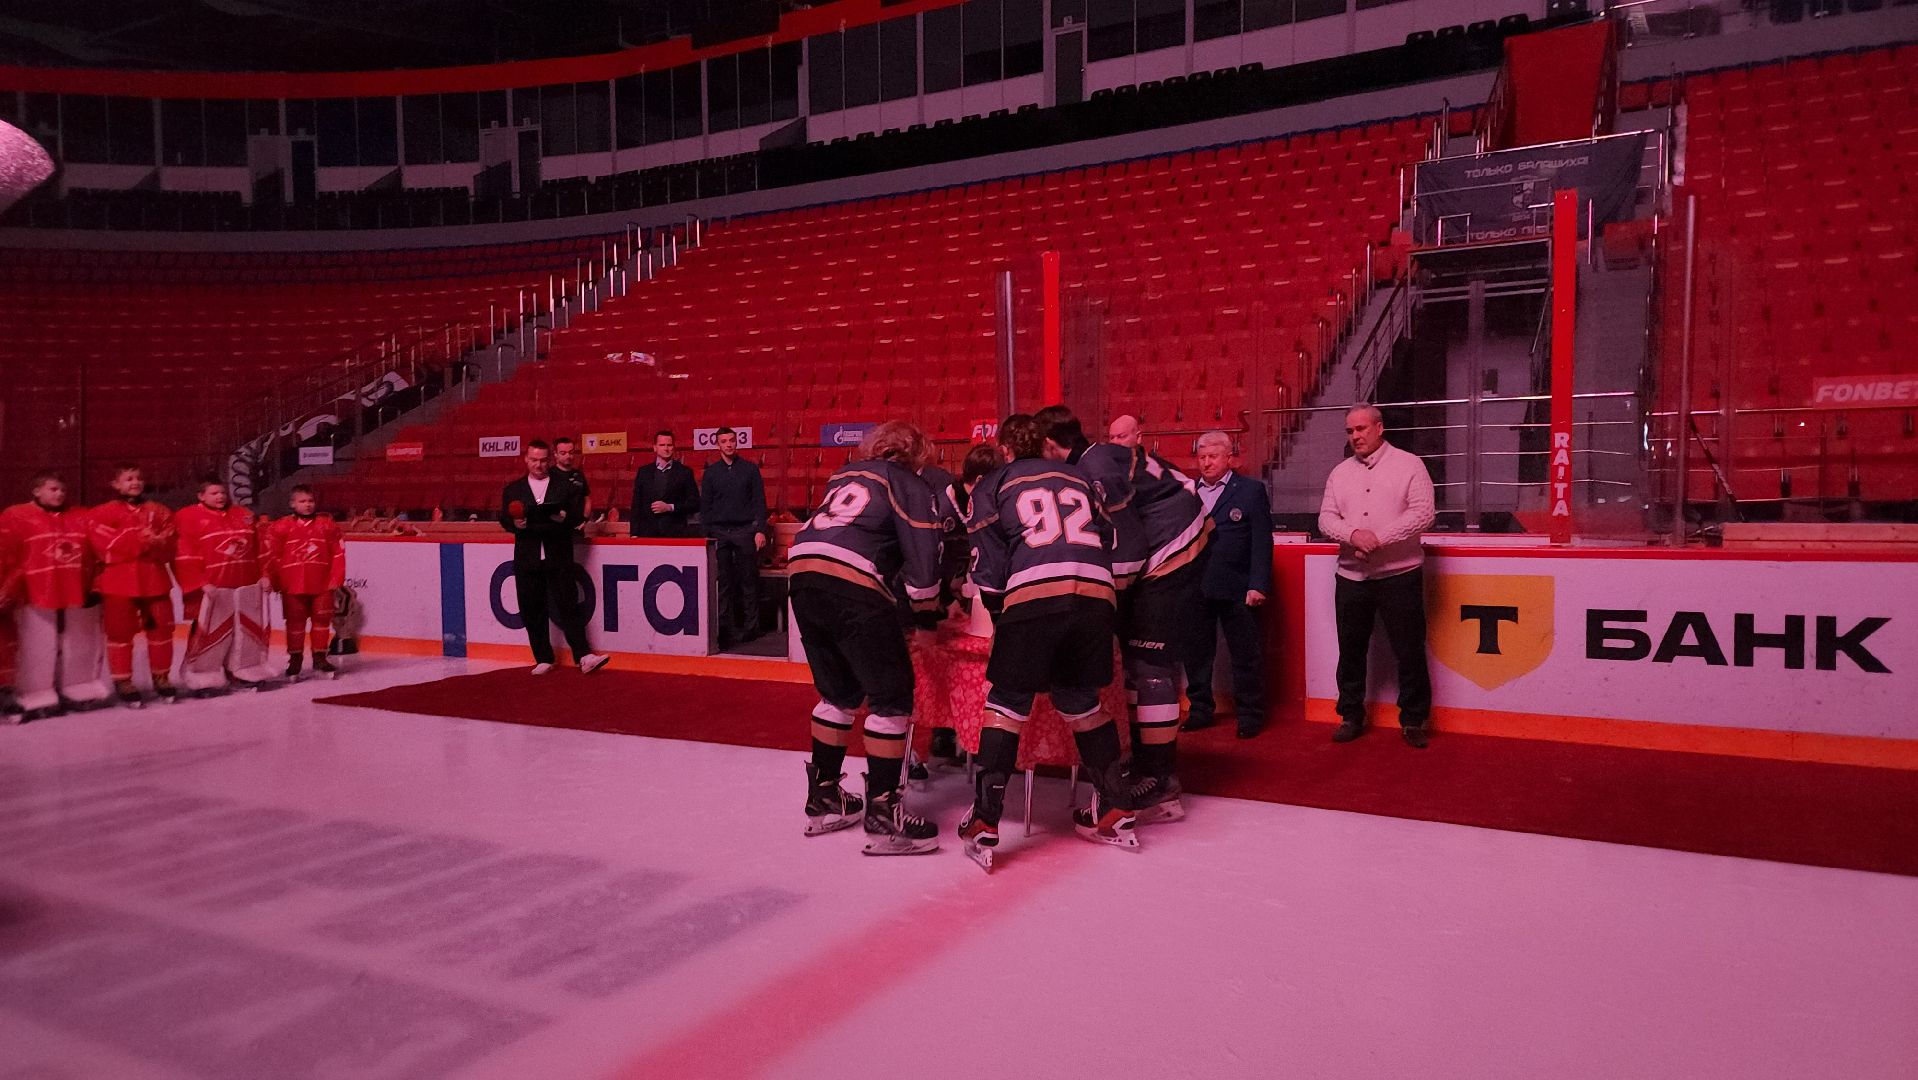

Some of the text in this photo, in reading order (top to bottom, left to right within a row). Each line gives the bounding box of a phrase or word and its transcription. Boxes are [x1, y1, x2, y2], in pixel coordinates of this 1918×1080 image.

[1464, 164, 1513, 178] ТОЛЬКО
[599, 438, 622, 447] БАНК
[699, 431, 748, 446] СОЗ
[482, 440, 518, 452] KHL.RU
[1016, 487, 1102, 549] 92
[1460, 604, 1893, 673] Т БАНК
